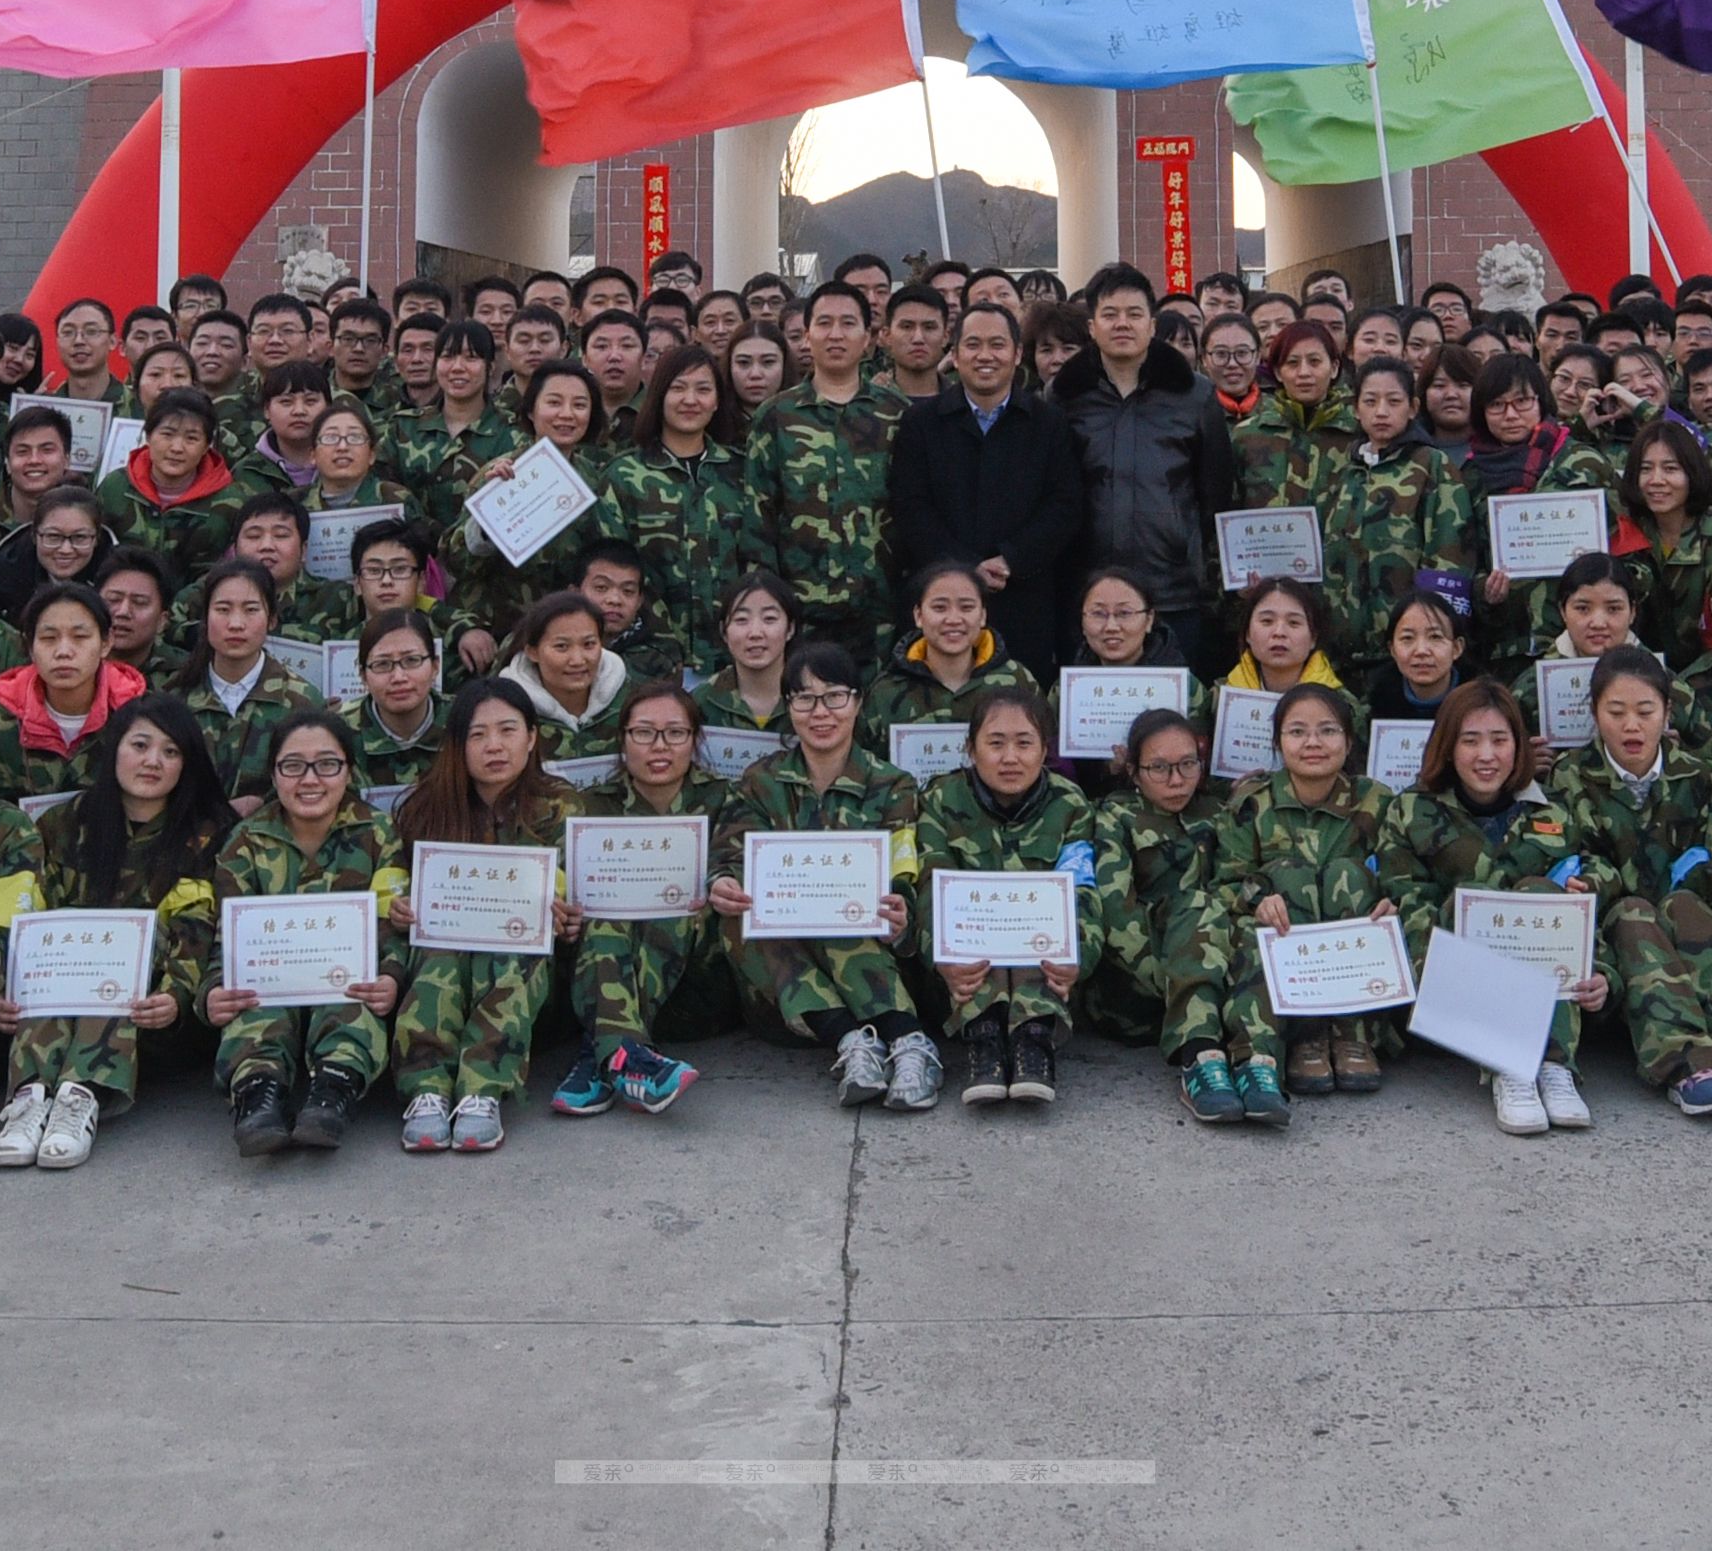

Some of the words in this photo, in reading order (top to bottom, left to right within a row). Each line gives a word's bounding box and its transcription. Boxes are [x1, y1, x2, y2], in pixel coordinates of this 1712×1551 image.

[648, 176, 666, 268] 順風順水
[1168, 171, 1187, 294] 好年好景好前
[1519, 509, 1576, 523] 结业证书
[1244, 522, 1295, 536] 结业证书
[1093, 686, 1155, 699] 结业证书
[602, 837, 671, 852] 结业证书
[782, 853, 852, 868] 结业证书
[448, 864, 518, 883] 结业证书
[969, 890, 1038, 904] 结业证书
[263, 915, 337, 934] 结业证书
[1492, 913, 1562, 931] 结业证书
[42, 931, 114, 946] 结业证书
[1297, 936, 1366, 956] 结业证书
